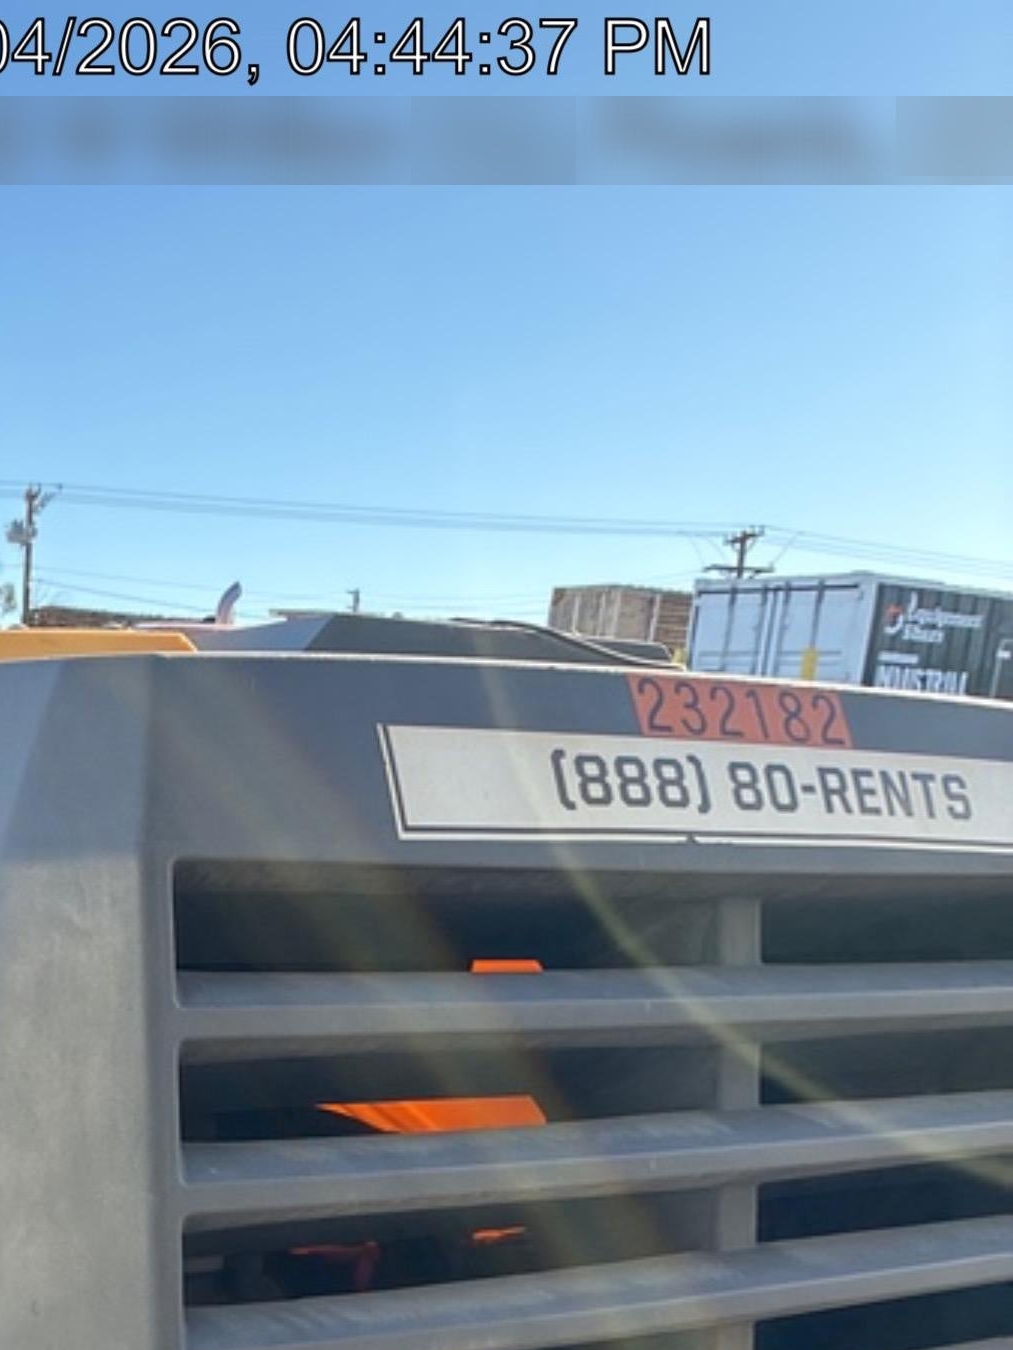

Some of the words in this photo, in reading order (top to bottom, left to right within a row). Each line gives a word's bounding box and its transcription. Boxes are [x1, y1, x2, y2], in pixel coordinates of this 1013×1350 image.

[638, 677, 845, 747] 232182
[550, 748, 711, 813] (888)
[727, 760, 972, 821] 80-RENTS
